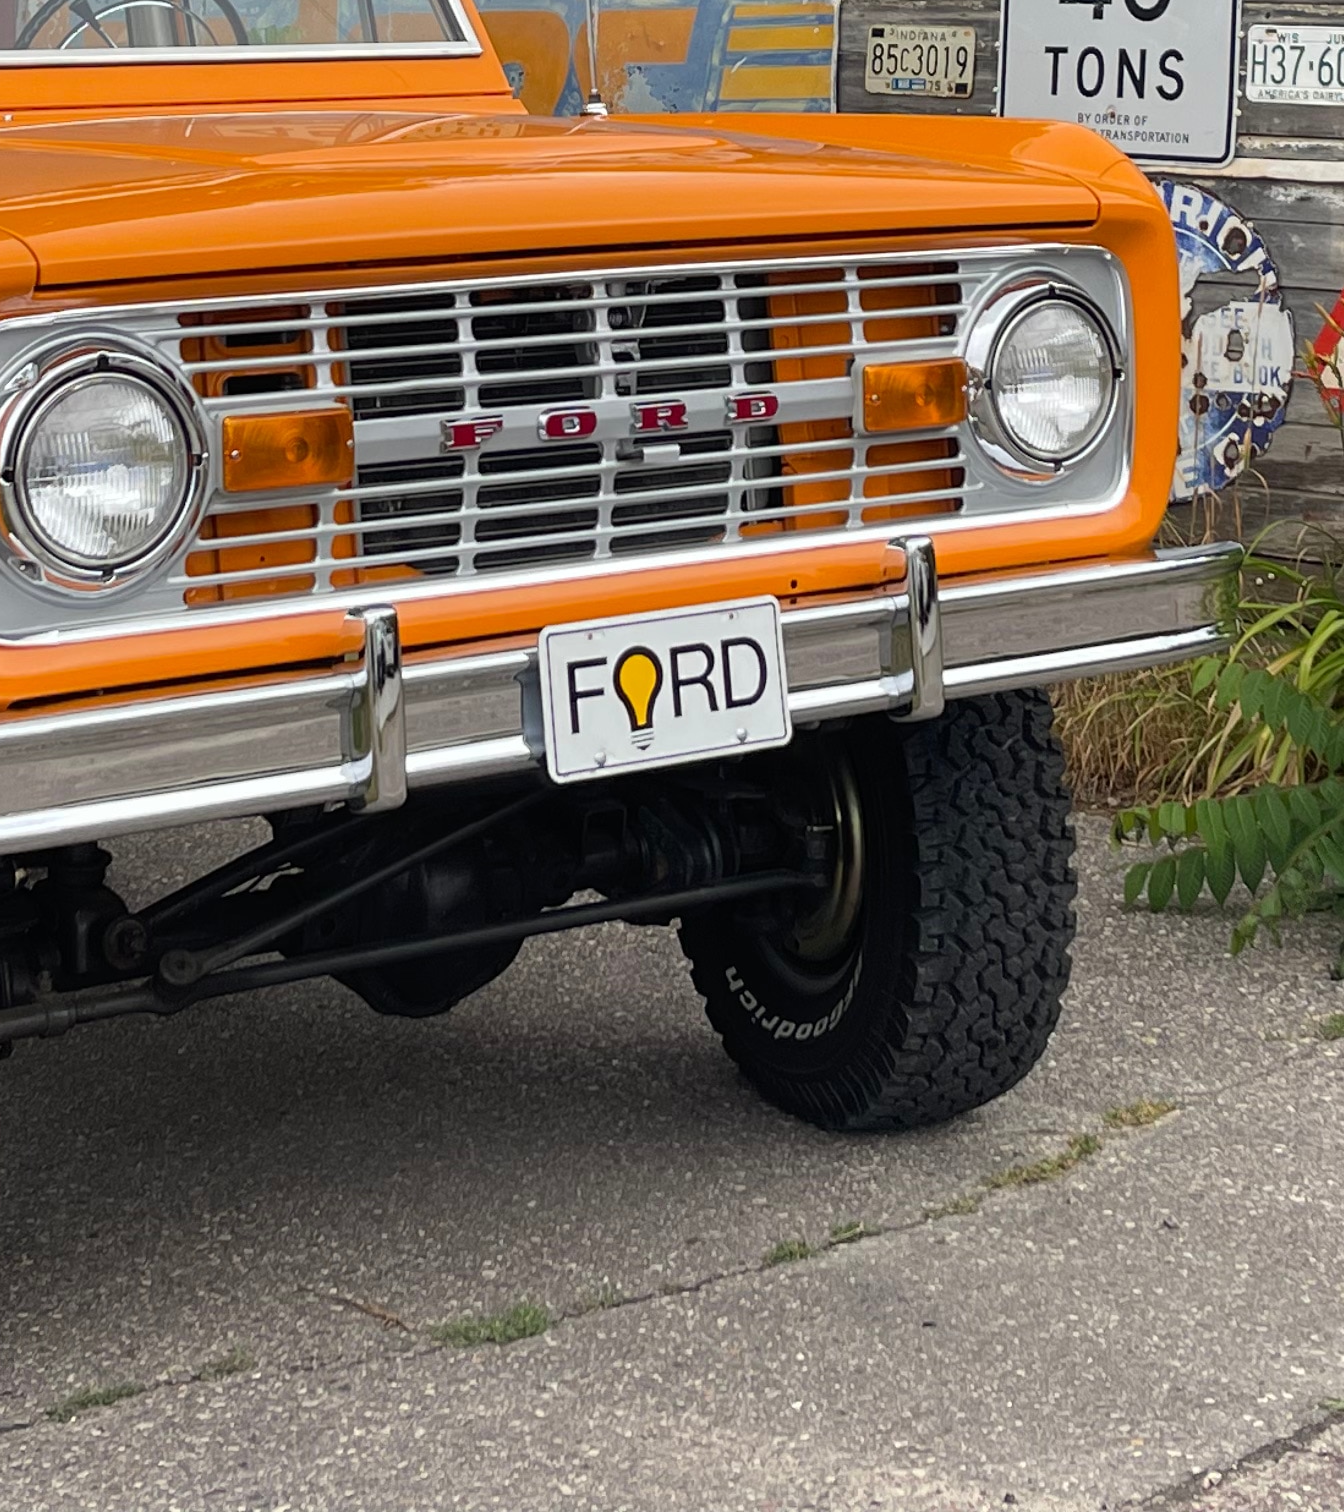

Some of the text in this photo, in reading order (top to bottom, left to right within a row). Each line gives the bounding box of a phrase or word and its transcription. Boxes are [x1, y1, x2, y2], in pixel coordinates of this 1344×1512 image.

[896, 31, 947, 42] INDIANA
[1277, 32, 1300, 43] WIS
[1044, 45, 1185, 101] TONS
[1257, 89, 1308, 100] AMERICA'S
[1077, 112, 1148, 127] BY ORDER OF
[1100, 128, 1190, 144] TRANSPORTATION
[440, 390, 779, 455] FORD
